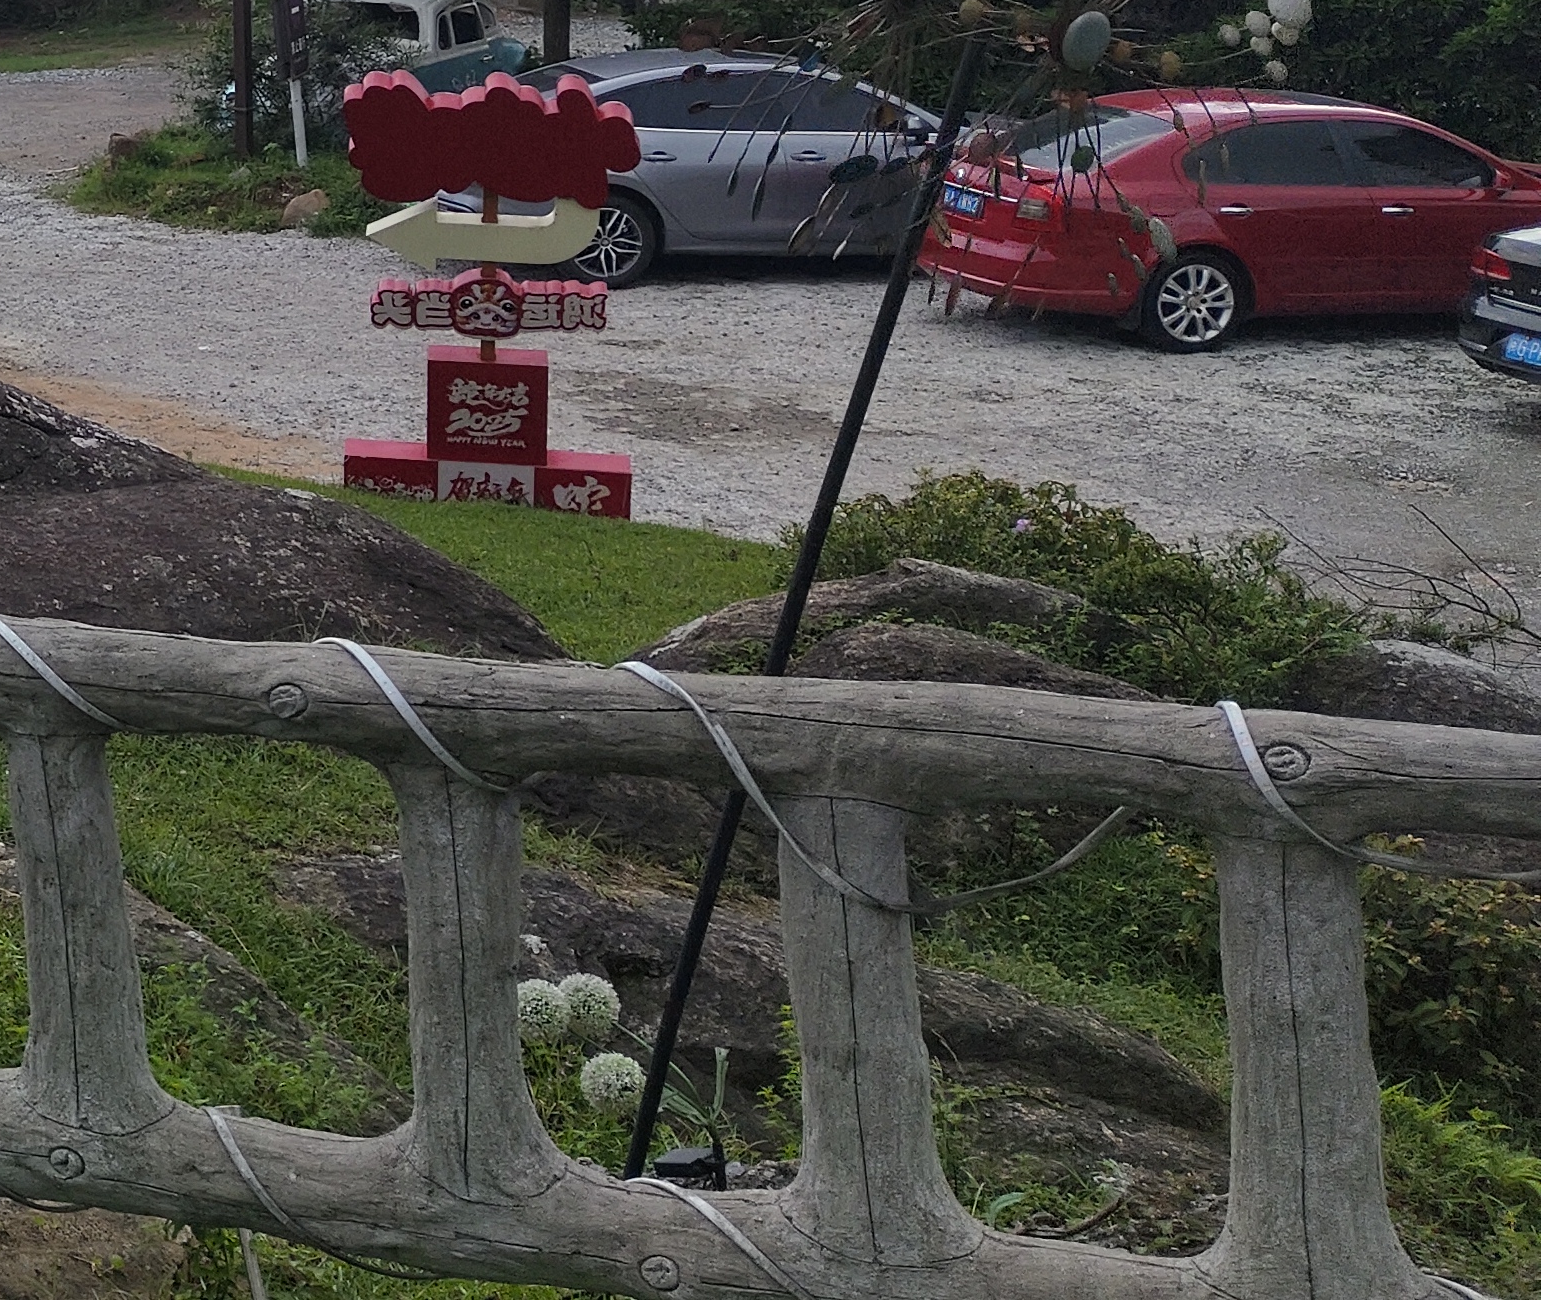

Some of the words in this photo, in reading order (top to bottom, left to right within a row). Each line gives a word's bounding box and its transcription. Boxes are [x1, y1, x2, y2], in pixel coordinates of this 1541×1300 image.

[445, 408, 530, 437] 2025
[447, 436, 471, 444] HAPPY
[473, 436, 498, 445] NEW
[500, 439, 527, 448] YEAR
